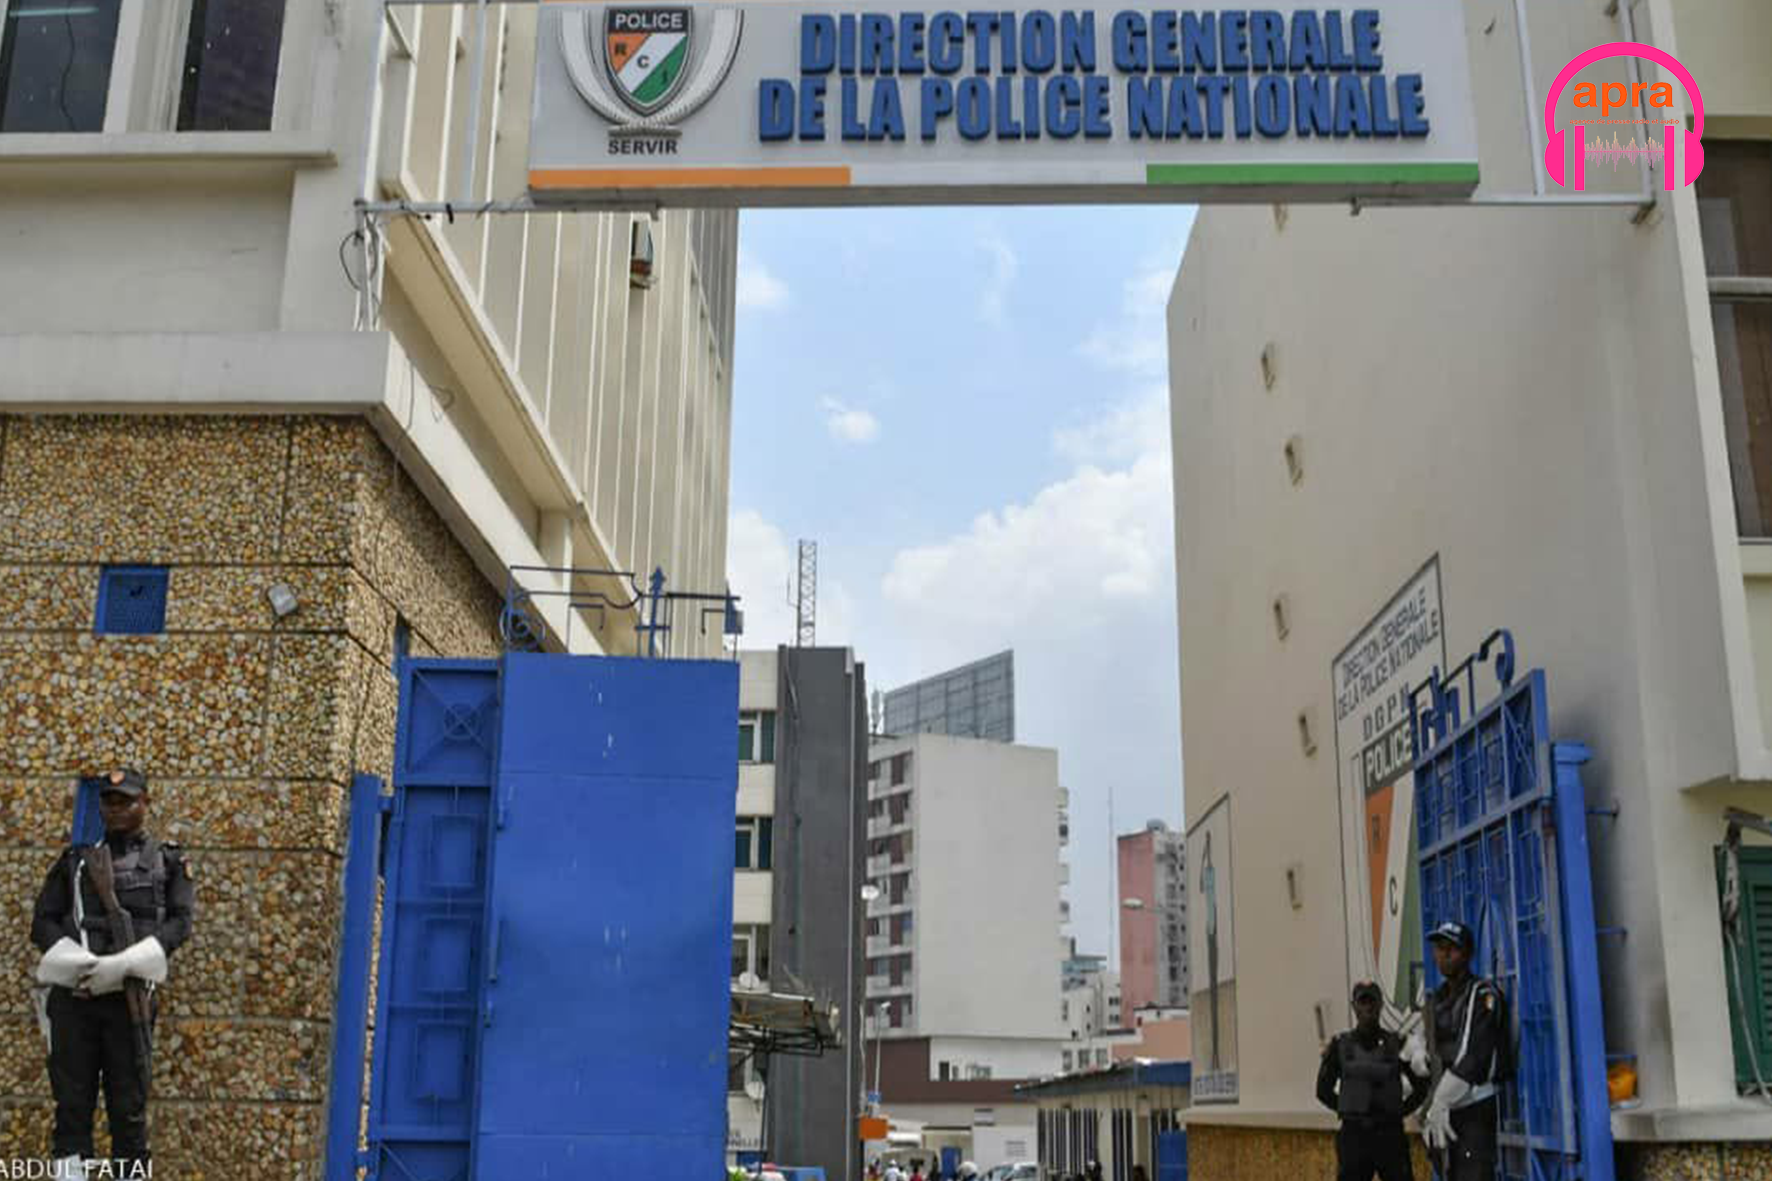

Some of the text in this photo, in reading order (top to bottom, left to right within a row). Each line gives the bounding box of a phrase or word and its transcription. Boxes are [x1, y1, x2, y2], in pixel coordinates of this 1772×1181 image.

[615, 12, 684, 30] POLICE
[614, 42, 628, 56] R
[636, 55, 650, 69] C
[800, 9, 1384, 75] DIRECTION GENERALE
[759, 73, 1430, 141] DE LA POLICE NATIONALE
[607, 139, 678, 155] SERVIR
[1360, 656, 1388, 702] POLICE
[1388, 609, 1439, 678] NATIONALE
[1365, 722, 1412, 788] POLICE
[1389, 876, 1399, 916] C
